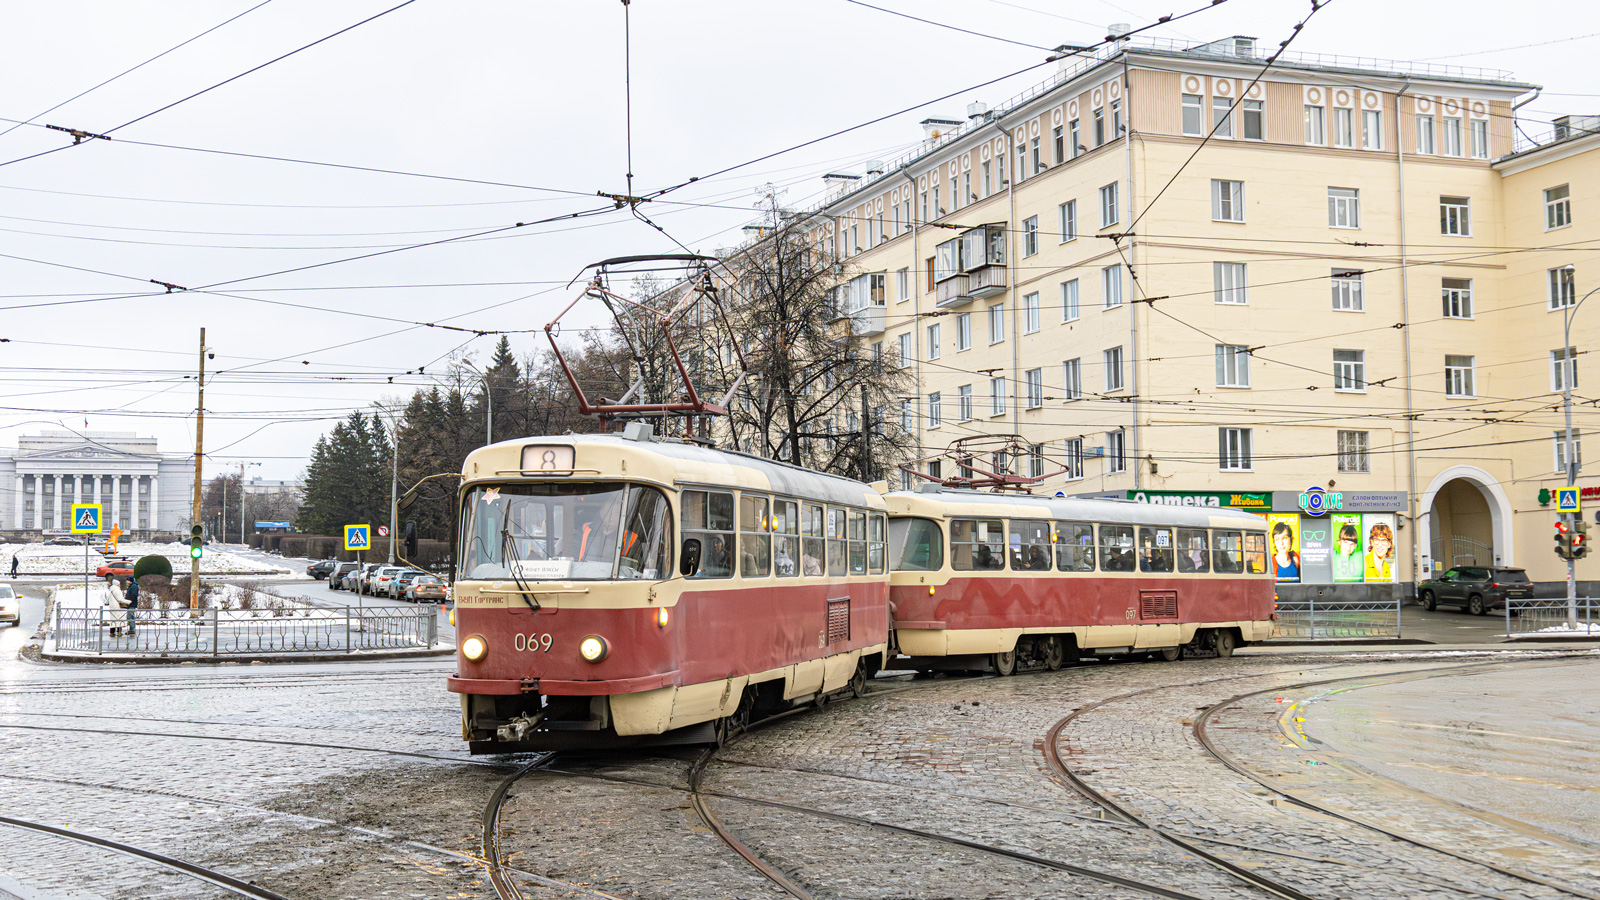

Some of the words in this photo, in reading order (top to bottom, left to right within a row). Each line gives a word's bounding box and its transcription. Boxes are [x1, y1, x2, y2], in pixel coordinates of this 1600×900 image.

[540, 450, 556, 474] 8
[1299, 493, 1343, 509] ФОКУС
[1270, 515, 1298, 523] Polaroid
[1333, 515, 1360, 523] Polaroid
[1157, 535, 1168, 545] 097
[1125, 610, 1136, 620] 097
[515, 632, 554, 653] 069
